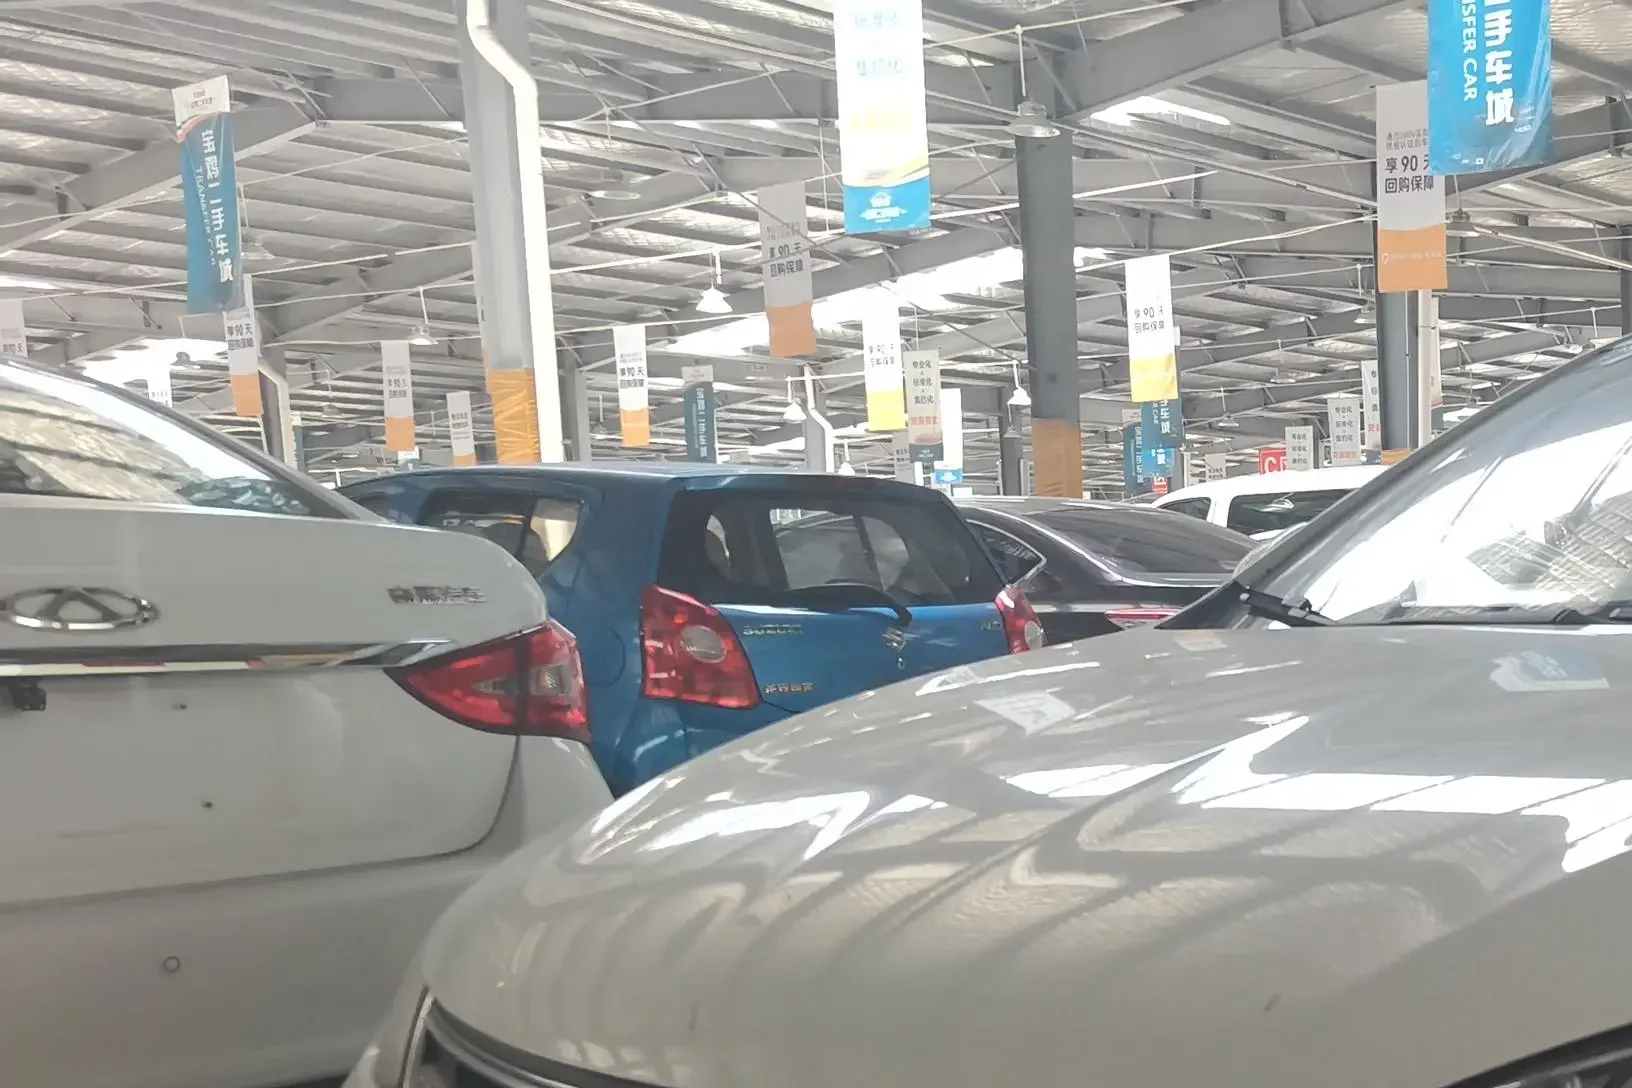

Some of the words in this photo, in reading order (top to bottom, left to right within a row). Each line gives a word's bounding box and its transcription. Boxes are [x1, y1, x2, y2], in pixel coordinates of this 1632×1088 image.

[1463, 58, 1478, 101] CAR
[1484, 0, 1514, 125] 手车城
[1385, 175, 1434, 194] 回购保障
